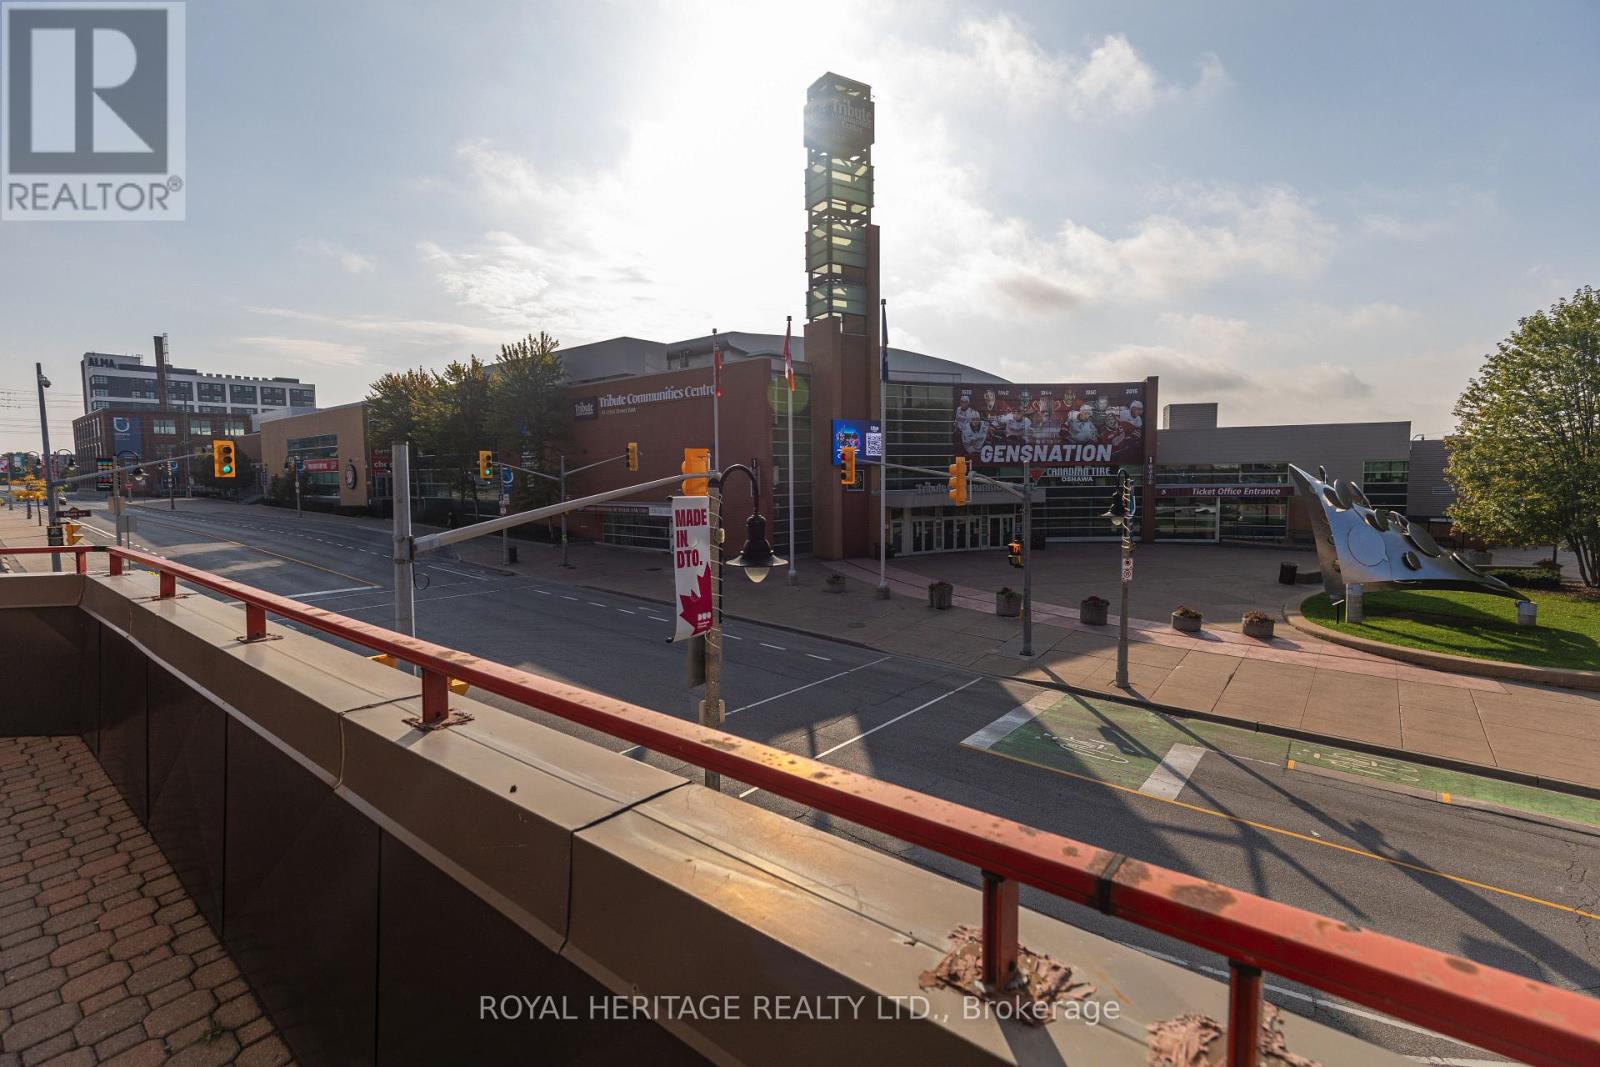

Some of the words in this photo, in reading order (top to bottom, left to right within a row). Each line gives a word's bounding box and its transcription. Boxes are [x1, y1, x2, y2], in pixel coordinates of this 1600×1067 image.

[88, 357, 115, 368] ALMA
[600, 393, 626, 408] Tribute
[627, 385, 684, 405] Communities
[980, 444, 1113, 463] GENSNATION
[1046, 467, 1089, 476] CANADIAN
[1091, 467, 1111, 475] TIRE
[1217, 487, 1241, 495] Office
[1243, 486, 1280, 495] Entrance
[675, 509, 707, 527] MADE
[676, 529, 689, 548] IN
[676, 549, 703, 568] DTO.
